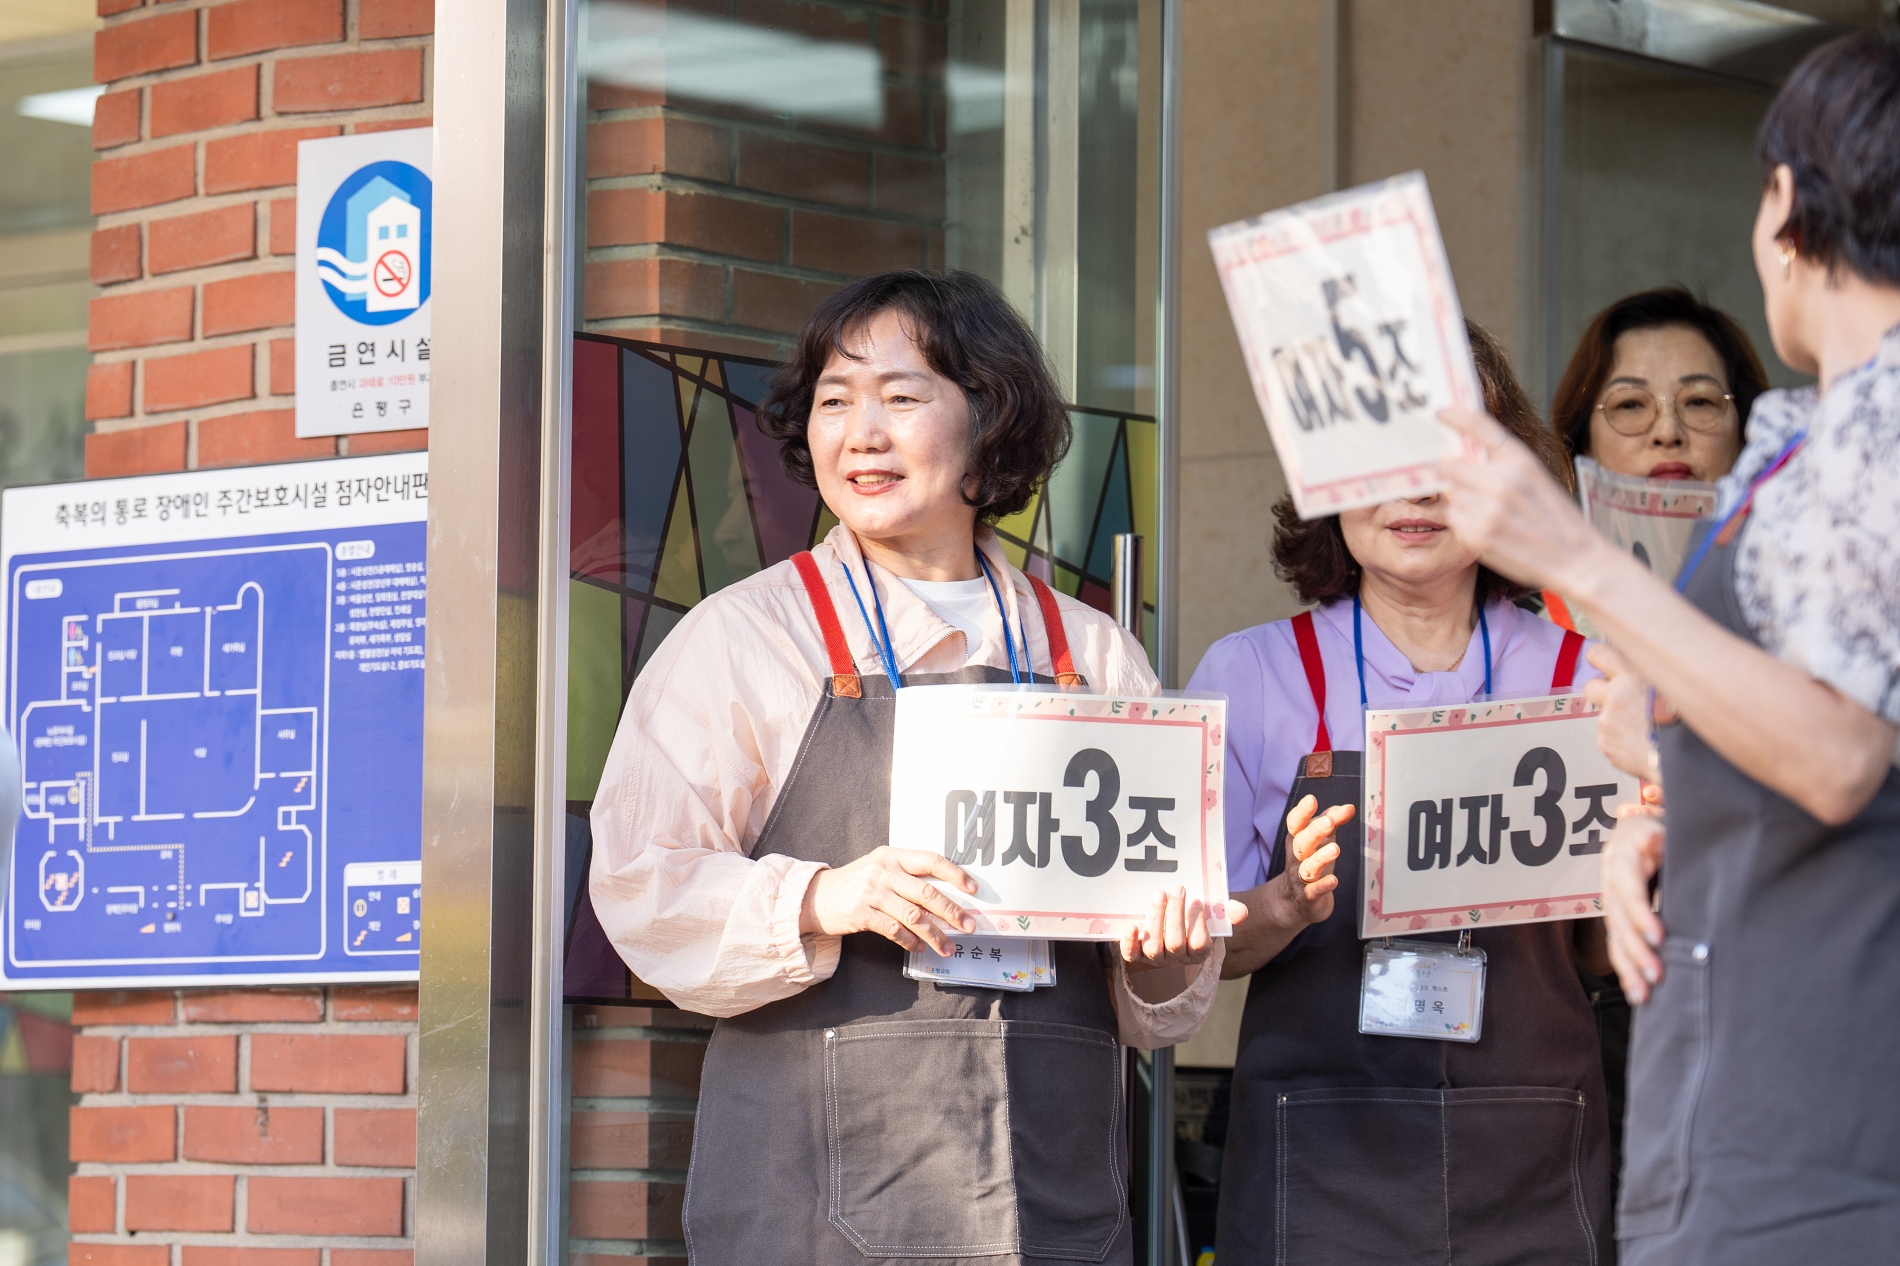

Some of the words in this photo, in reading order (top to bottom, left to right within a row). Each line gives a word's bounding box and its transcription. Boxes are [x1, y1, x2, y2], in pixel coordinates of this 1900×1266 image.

[418, 373, 430, 384] 부
[56, 501, 106, 528] 축복의
[115, 498, 147, 525] 통로
[157, 492, 208, 521] 장애인
[217, 481, 327, 515] 주간보호시설
[336, 473, 428, 505] 점자안내판
[944, 748, 1178, 877] 여자3조
[1407, 747, 1618, 872] 여자3조
